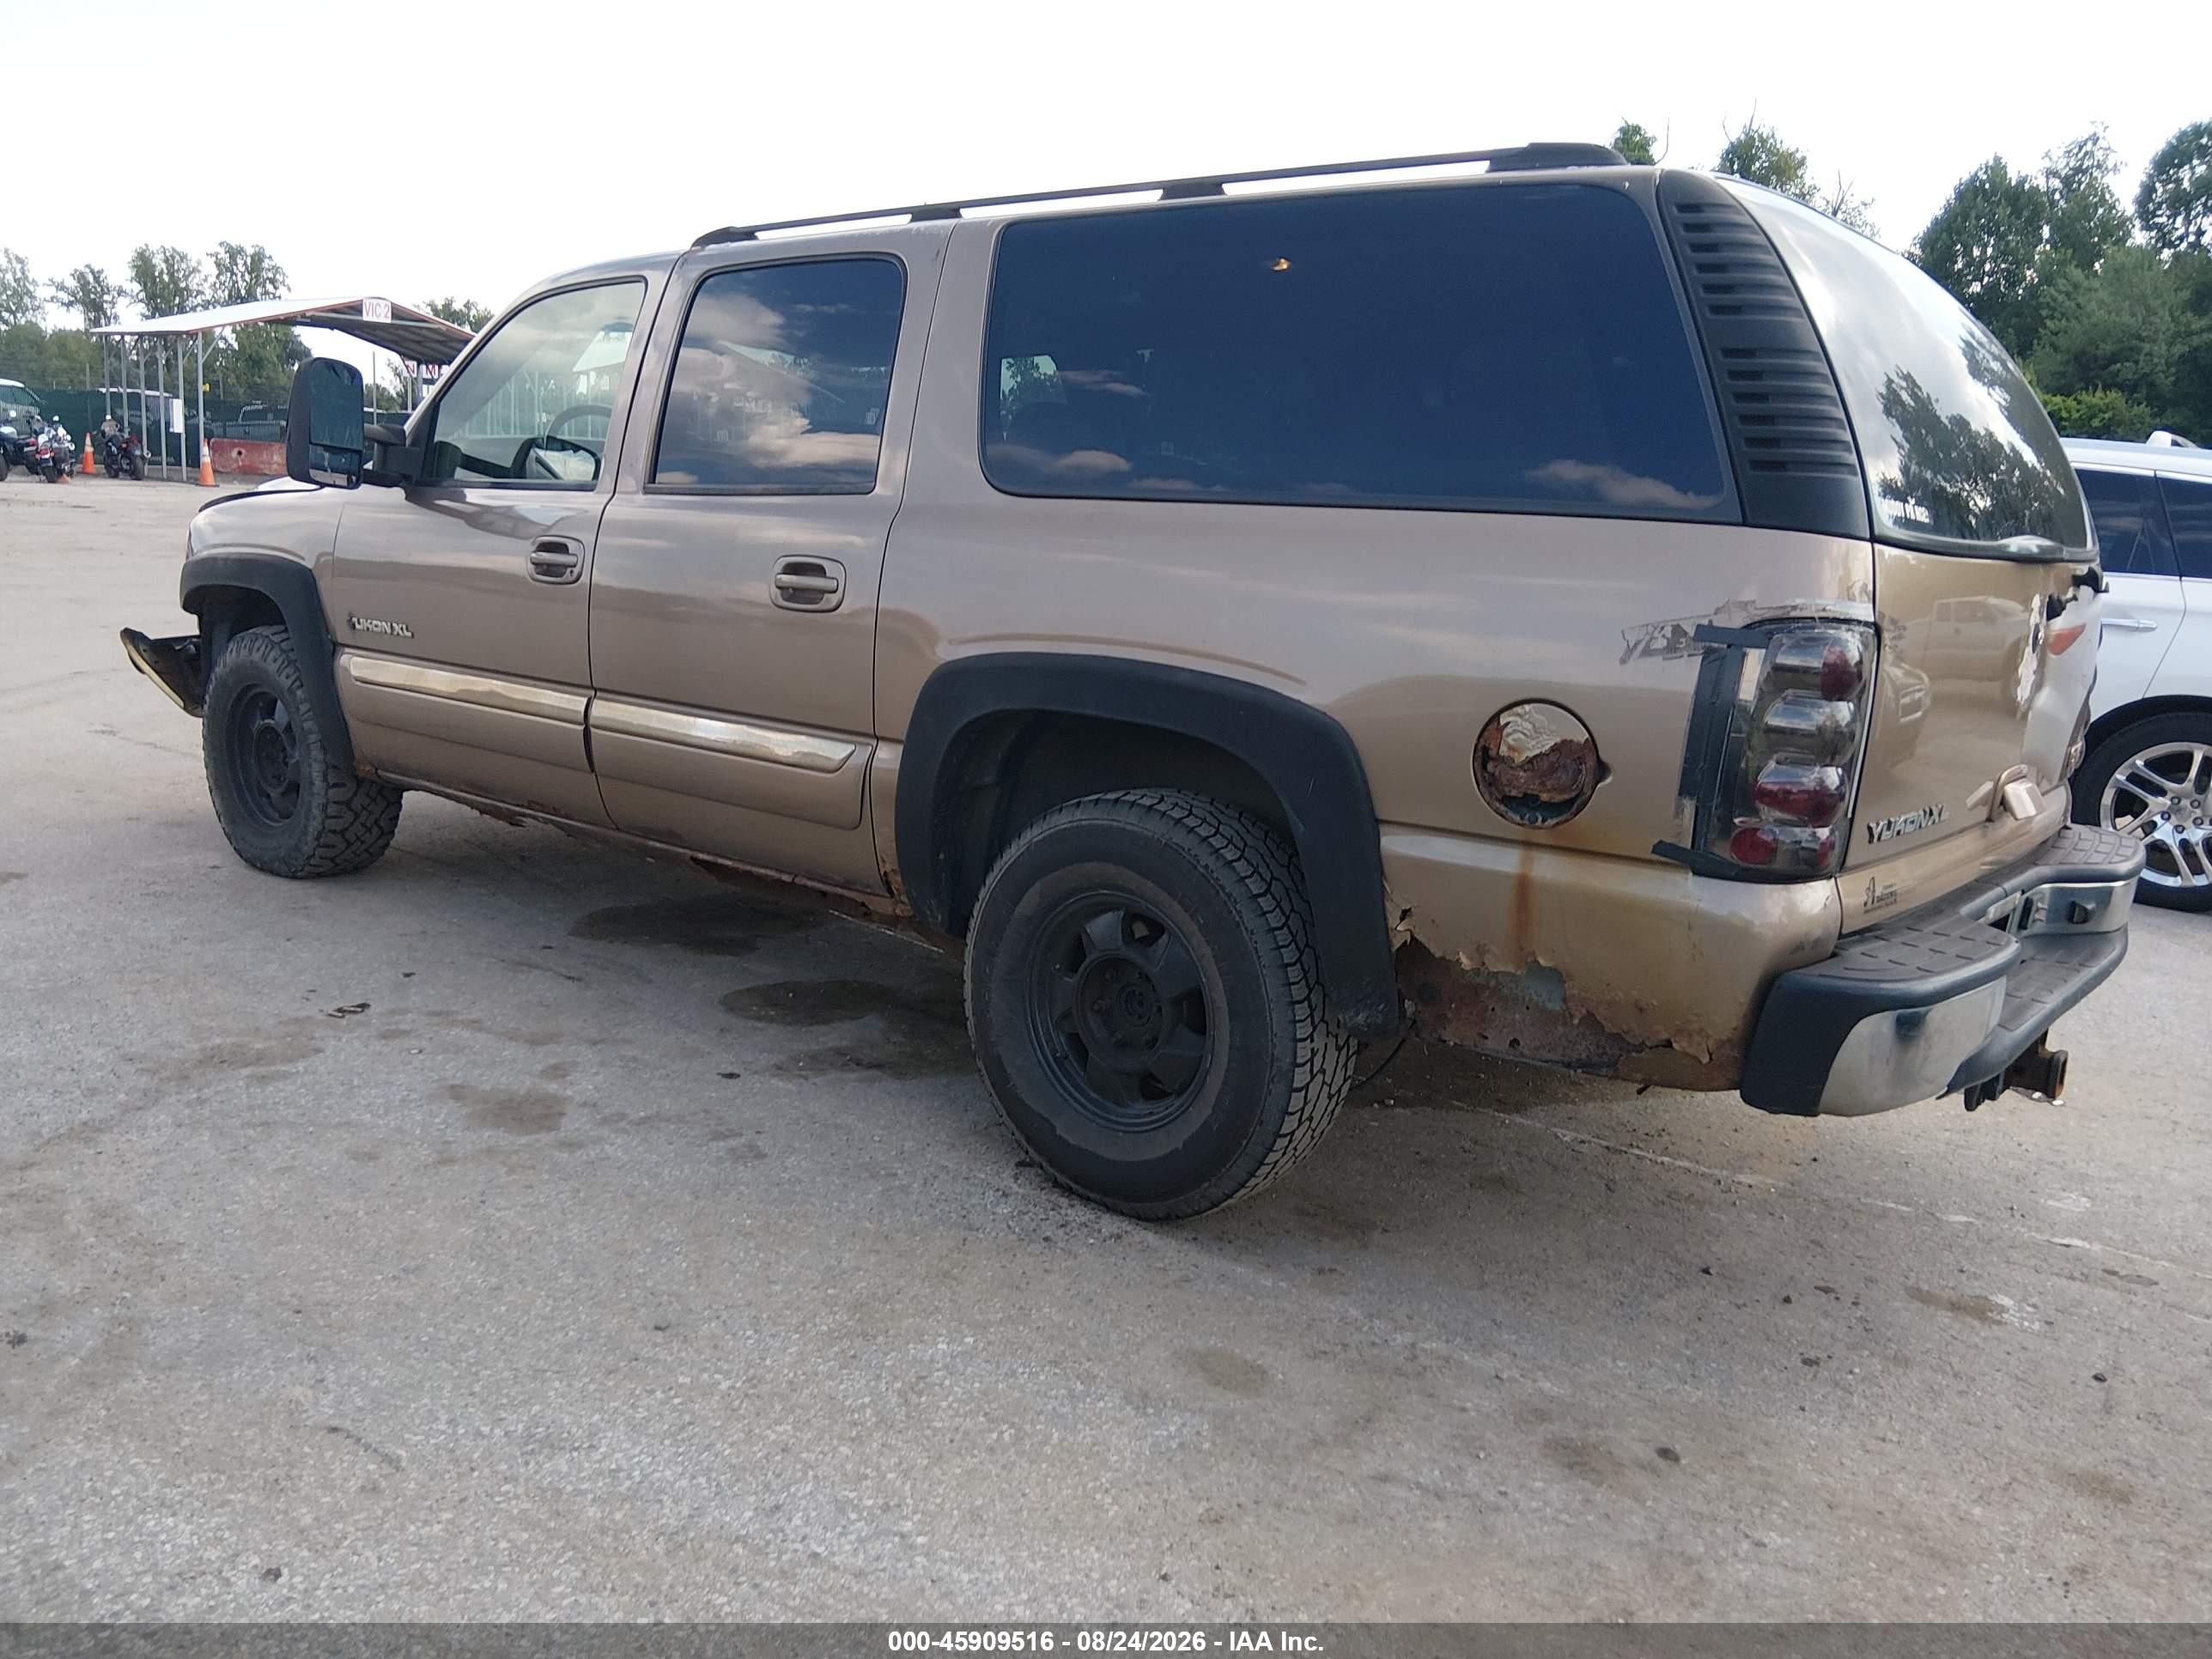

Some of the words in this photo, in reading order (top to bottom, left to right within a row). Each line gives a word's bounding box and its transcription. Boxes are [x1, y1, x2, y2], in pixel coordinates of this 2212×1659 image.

[364, 301, 381, 318] VIC
[384, 303, 391, 319] 2
[392, 622, 413, 637] XL
[1868, 806, 1929, 843] YUKON
